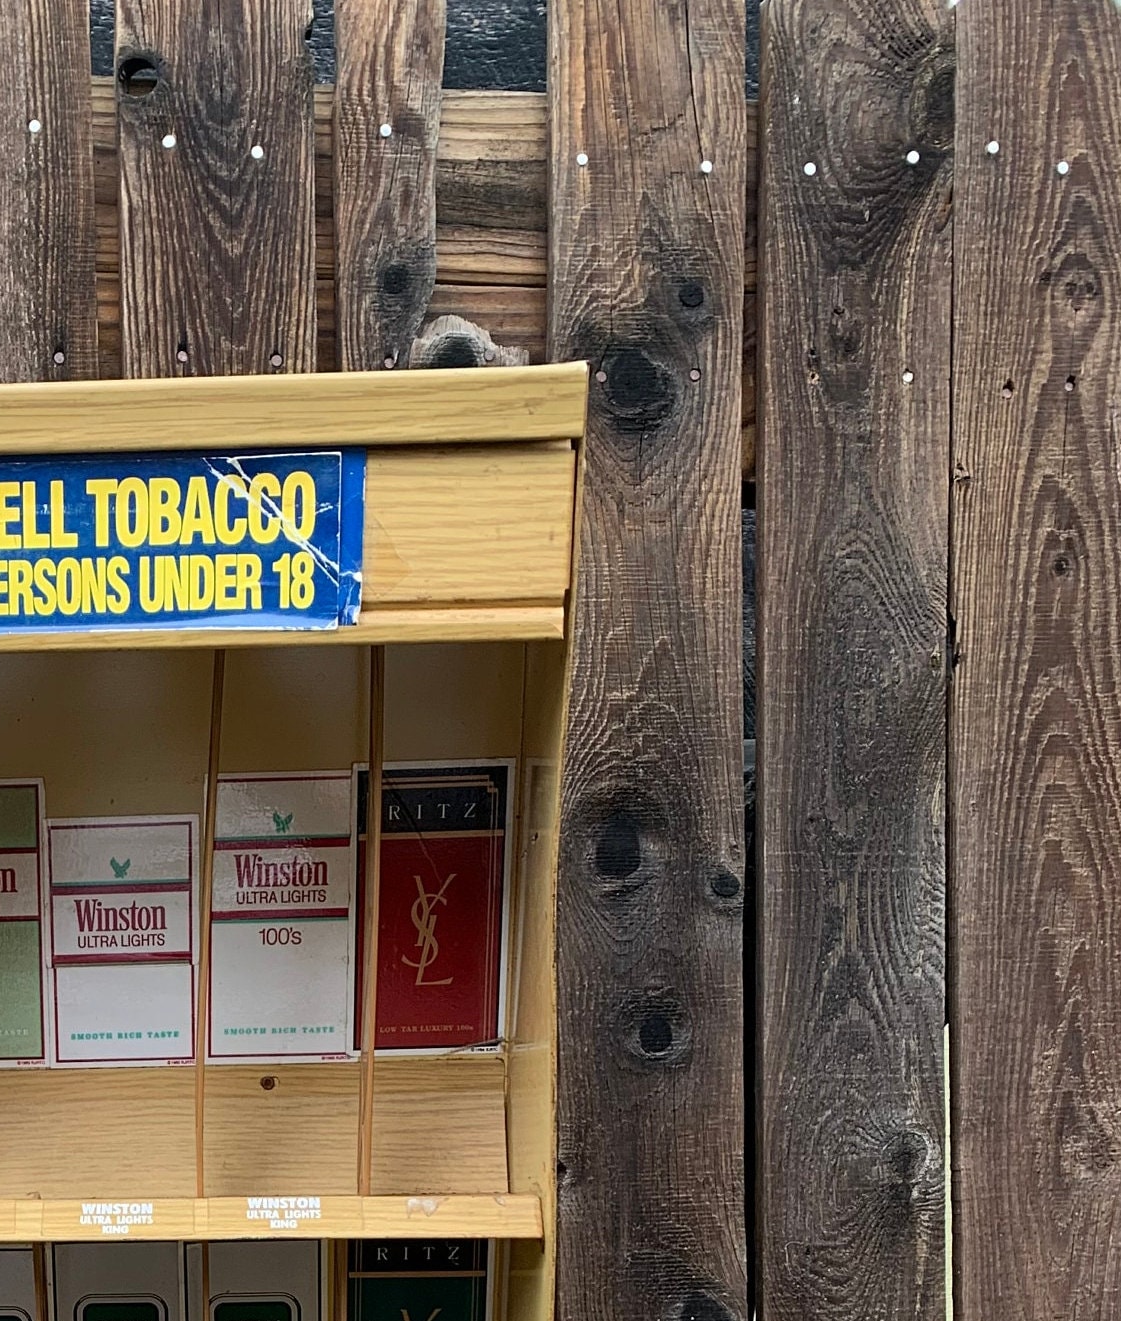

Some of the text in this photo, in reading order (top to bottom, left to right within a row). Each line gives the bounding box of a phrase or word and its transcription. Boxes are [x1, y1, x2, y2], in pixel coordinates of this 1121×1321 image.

[86, 471, 316, 548] TOBACCO
[139, 553, 262, 613] UNDER
[272, 551, 315, 610] 18
[389, 803, 476, 821] RITZ
[234, 854, 328, 888] Winston
[236, 889, 326, 904] ULTRA LIGHTS
[74, 899, 167, 932] Winston
[78, 933, 165, 948] ULTRA LIGHTS
[259, 928, 302, 945] 100's
[81, 1203, 153, 1214] WINSTON
[247, 1197, 320, 1209] WINSTON
[80, 1215, 153, 1225] ULTRA LIGHTS
[246, 1209, 321, 1219] ULTRA LIGHTS
[102, 1225, 129, 1234] KING
[270, 1219, 298, 1229] KING
[377, 1247, 460, 1261] RITZ
